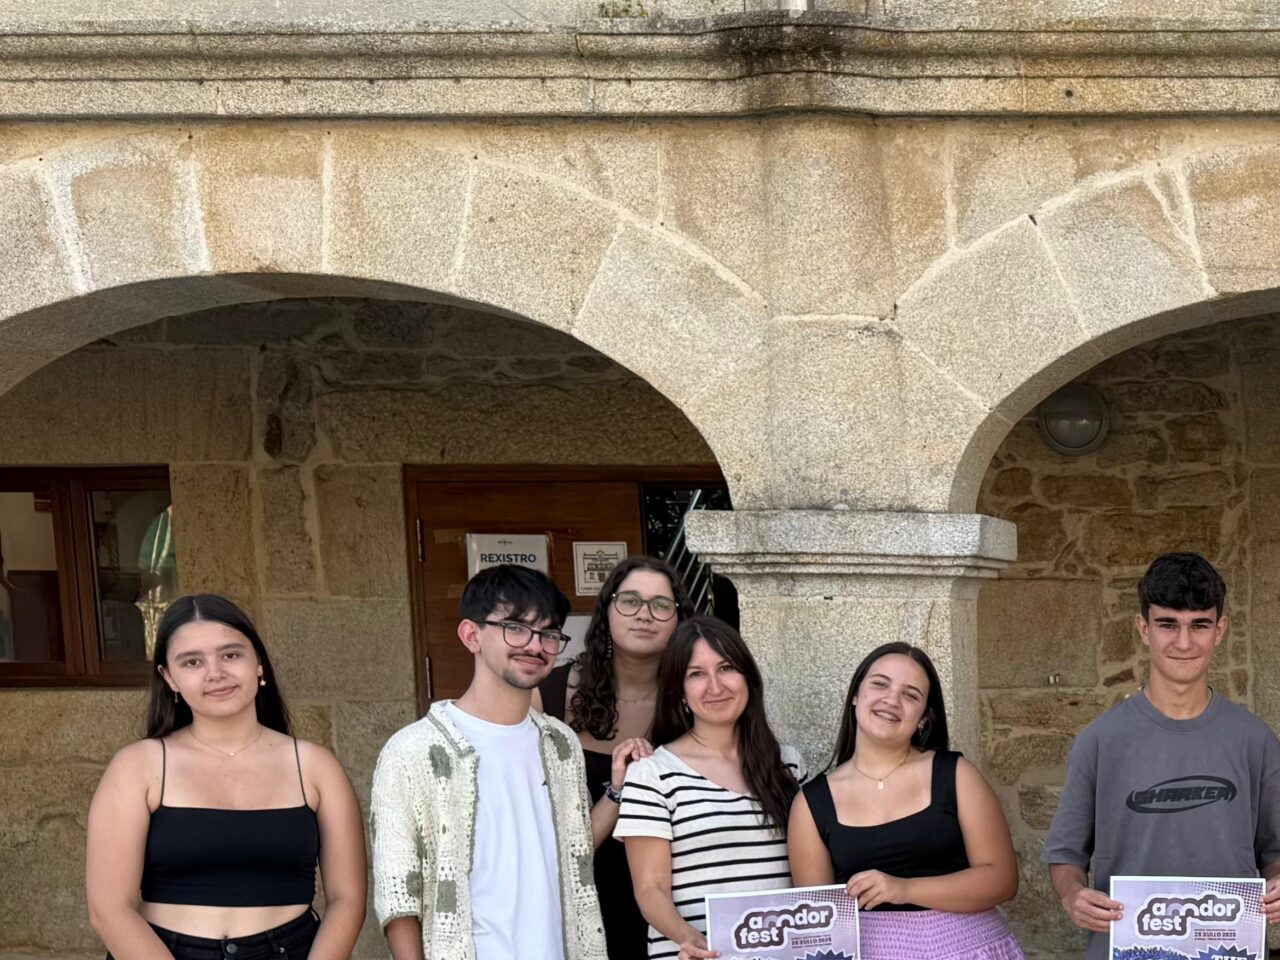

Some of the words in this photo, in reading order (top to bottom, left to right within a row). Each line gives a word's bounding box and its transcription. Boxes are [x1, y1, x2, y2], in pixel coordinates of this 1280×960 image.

[480, 553, 537, 563] REXISTRO
[1142, 913, 1182, 931] fest
[739, 927, 780, 944] fest
